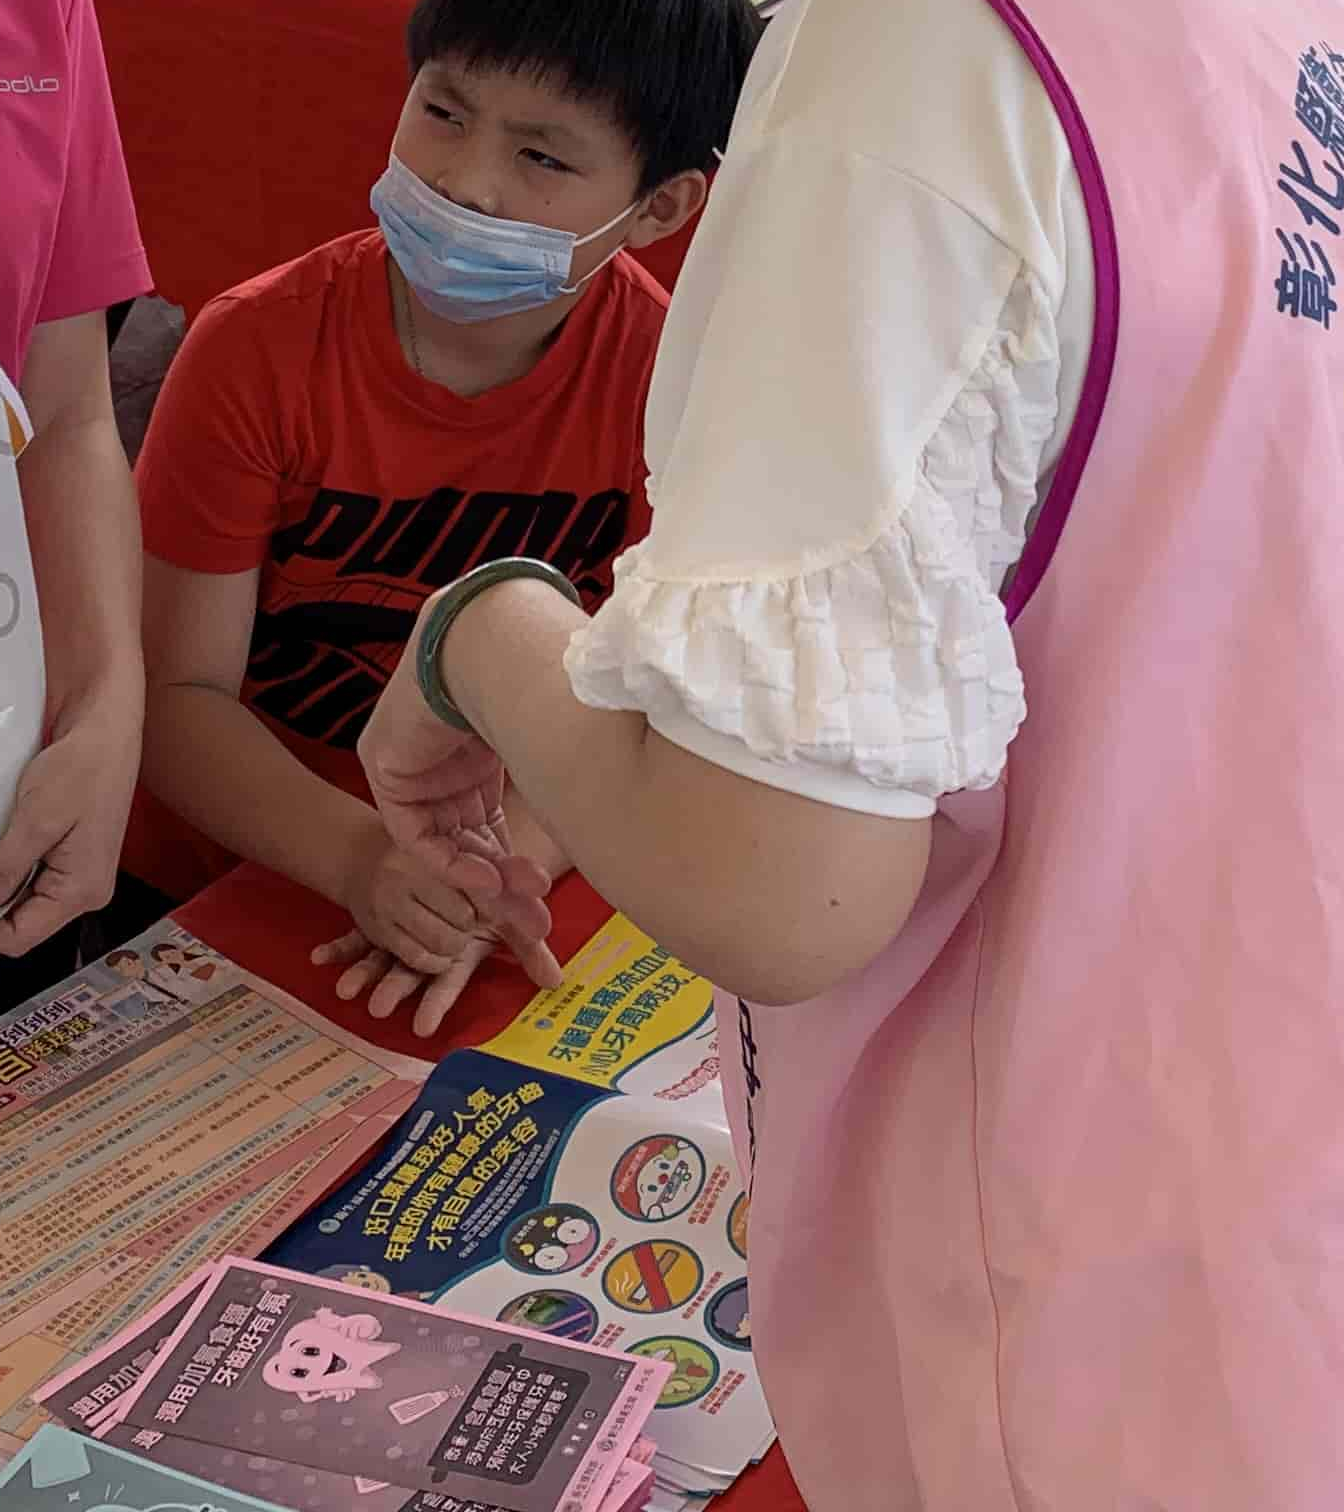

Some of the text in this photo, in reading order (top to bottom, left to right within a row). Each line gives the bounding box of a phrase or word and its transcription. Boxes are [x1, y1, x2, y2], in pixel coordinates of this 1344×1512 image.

[361, 1085, 500, 1239] 好口氣讓我好人氣
[382, 1080, 547, 1263] 年輕的你有健康的牙齒
[426, 1117, 541, 1252] 才有自信的笑容
